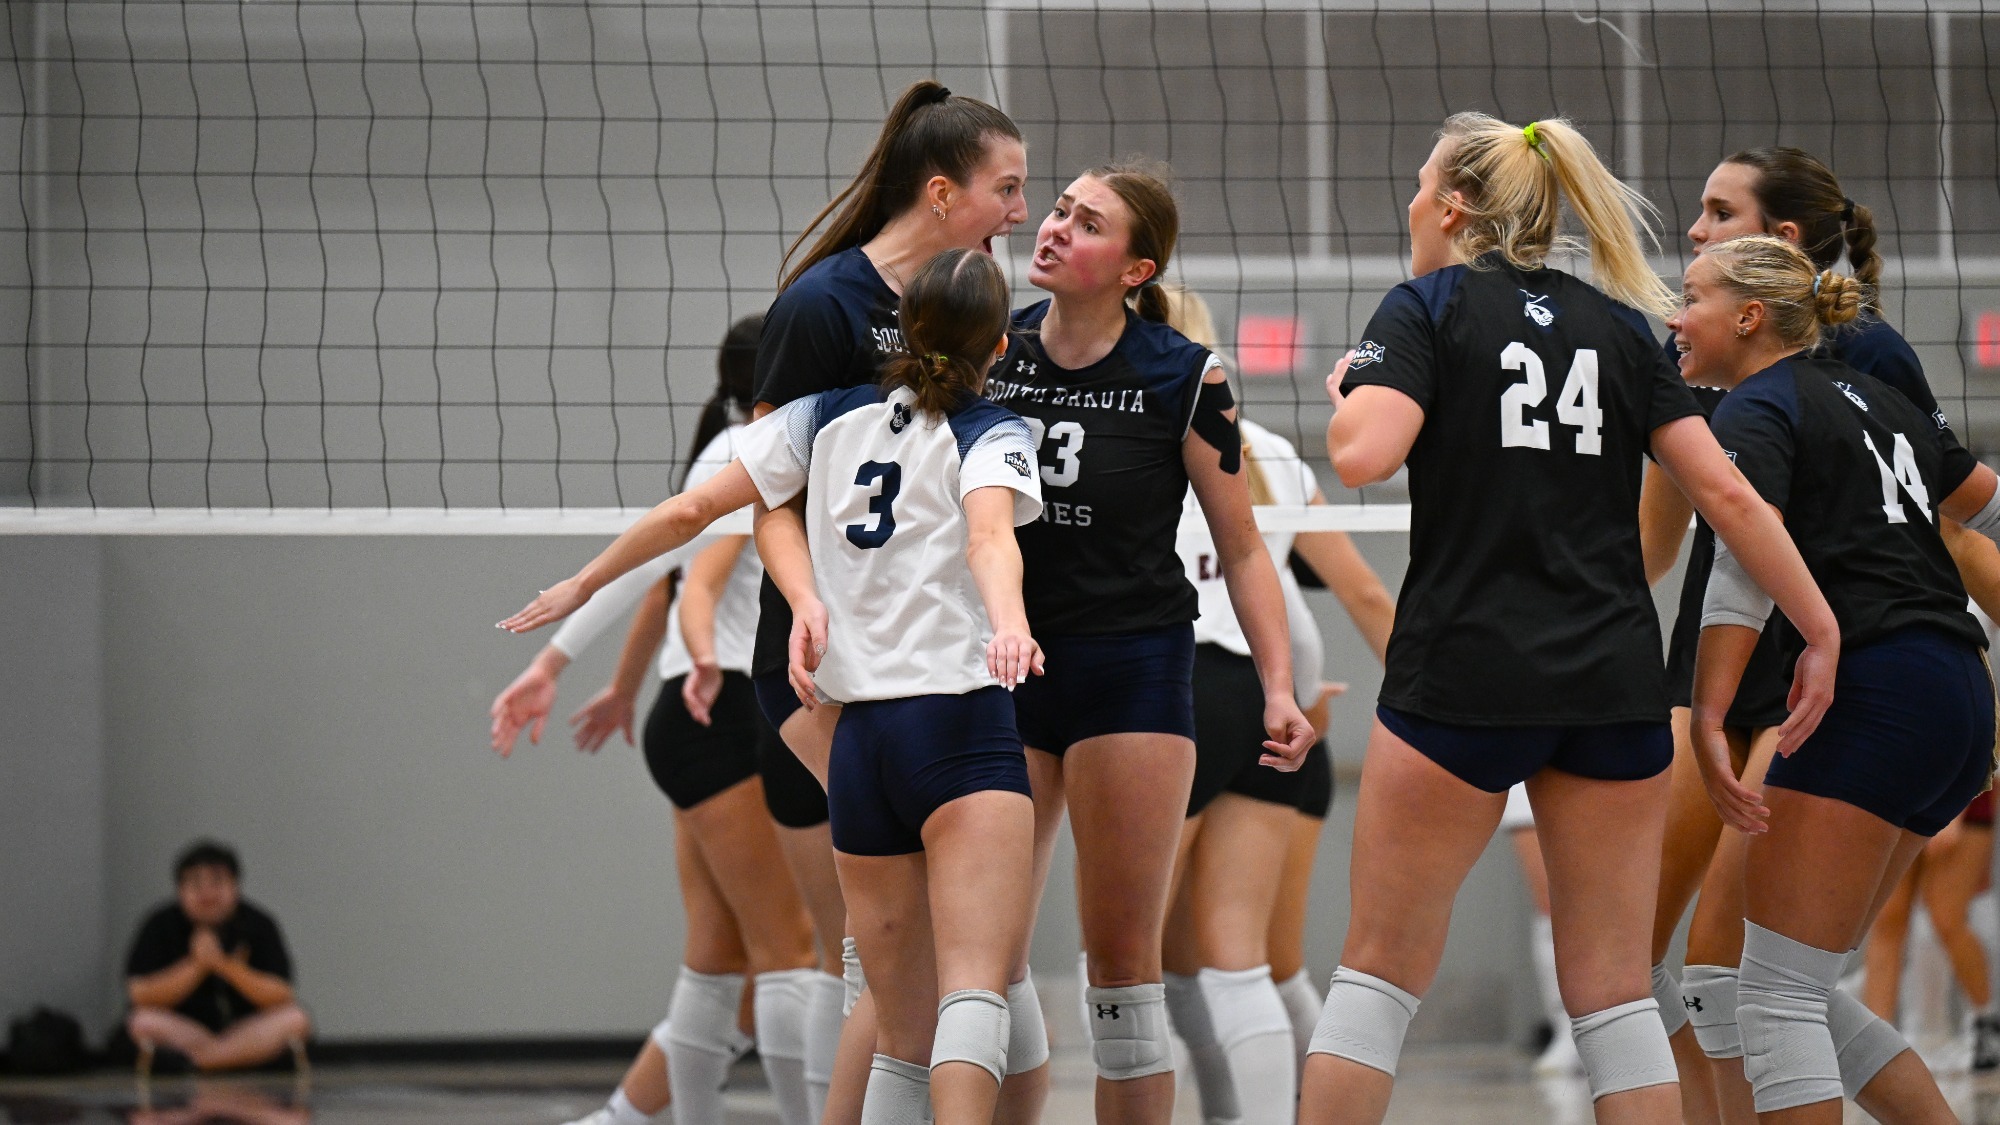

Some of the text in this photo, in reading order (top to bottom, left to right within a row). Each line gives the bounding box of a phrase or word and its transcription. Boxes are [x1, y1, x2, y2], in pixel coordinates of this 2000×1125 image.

[871, 327, 906, 353] SOU
[1354, 349, 1382, 360] MAC
[985, 378, 1144, 413] SOUTH DAKOTA
[1500, 341, 1603, 455] 24
[1863, 430, 1933, 524] 14
[846, 460, 901, 550] 3
[1036, 501, 1092, 527] NES
